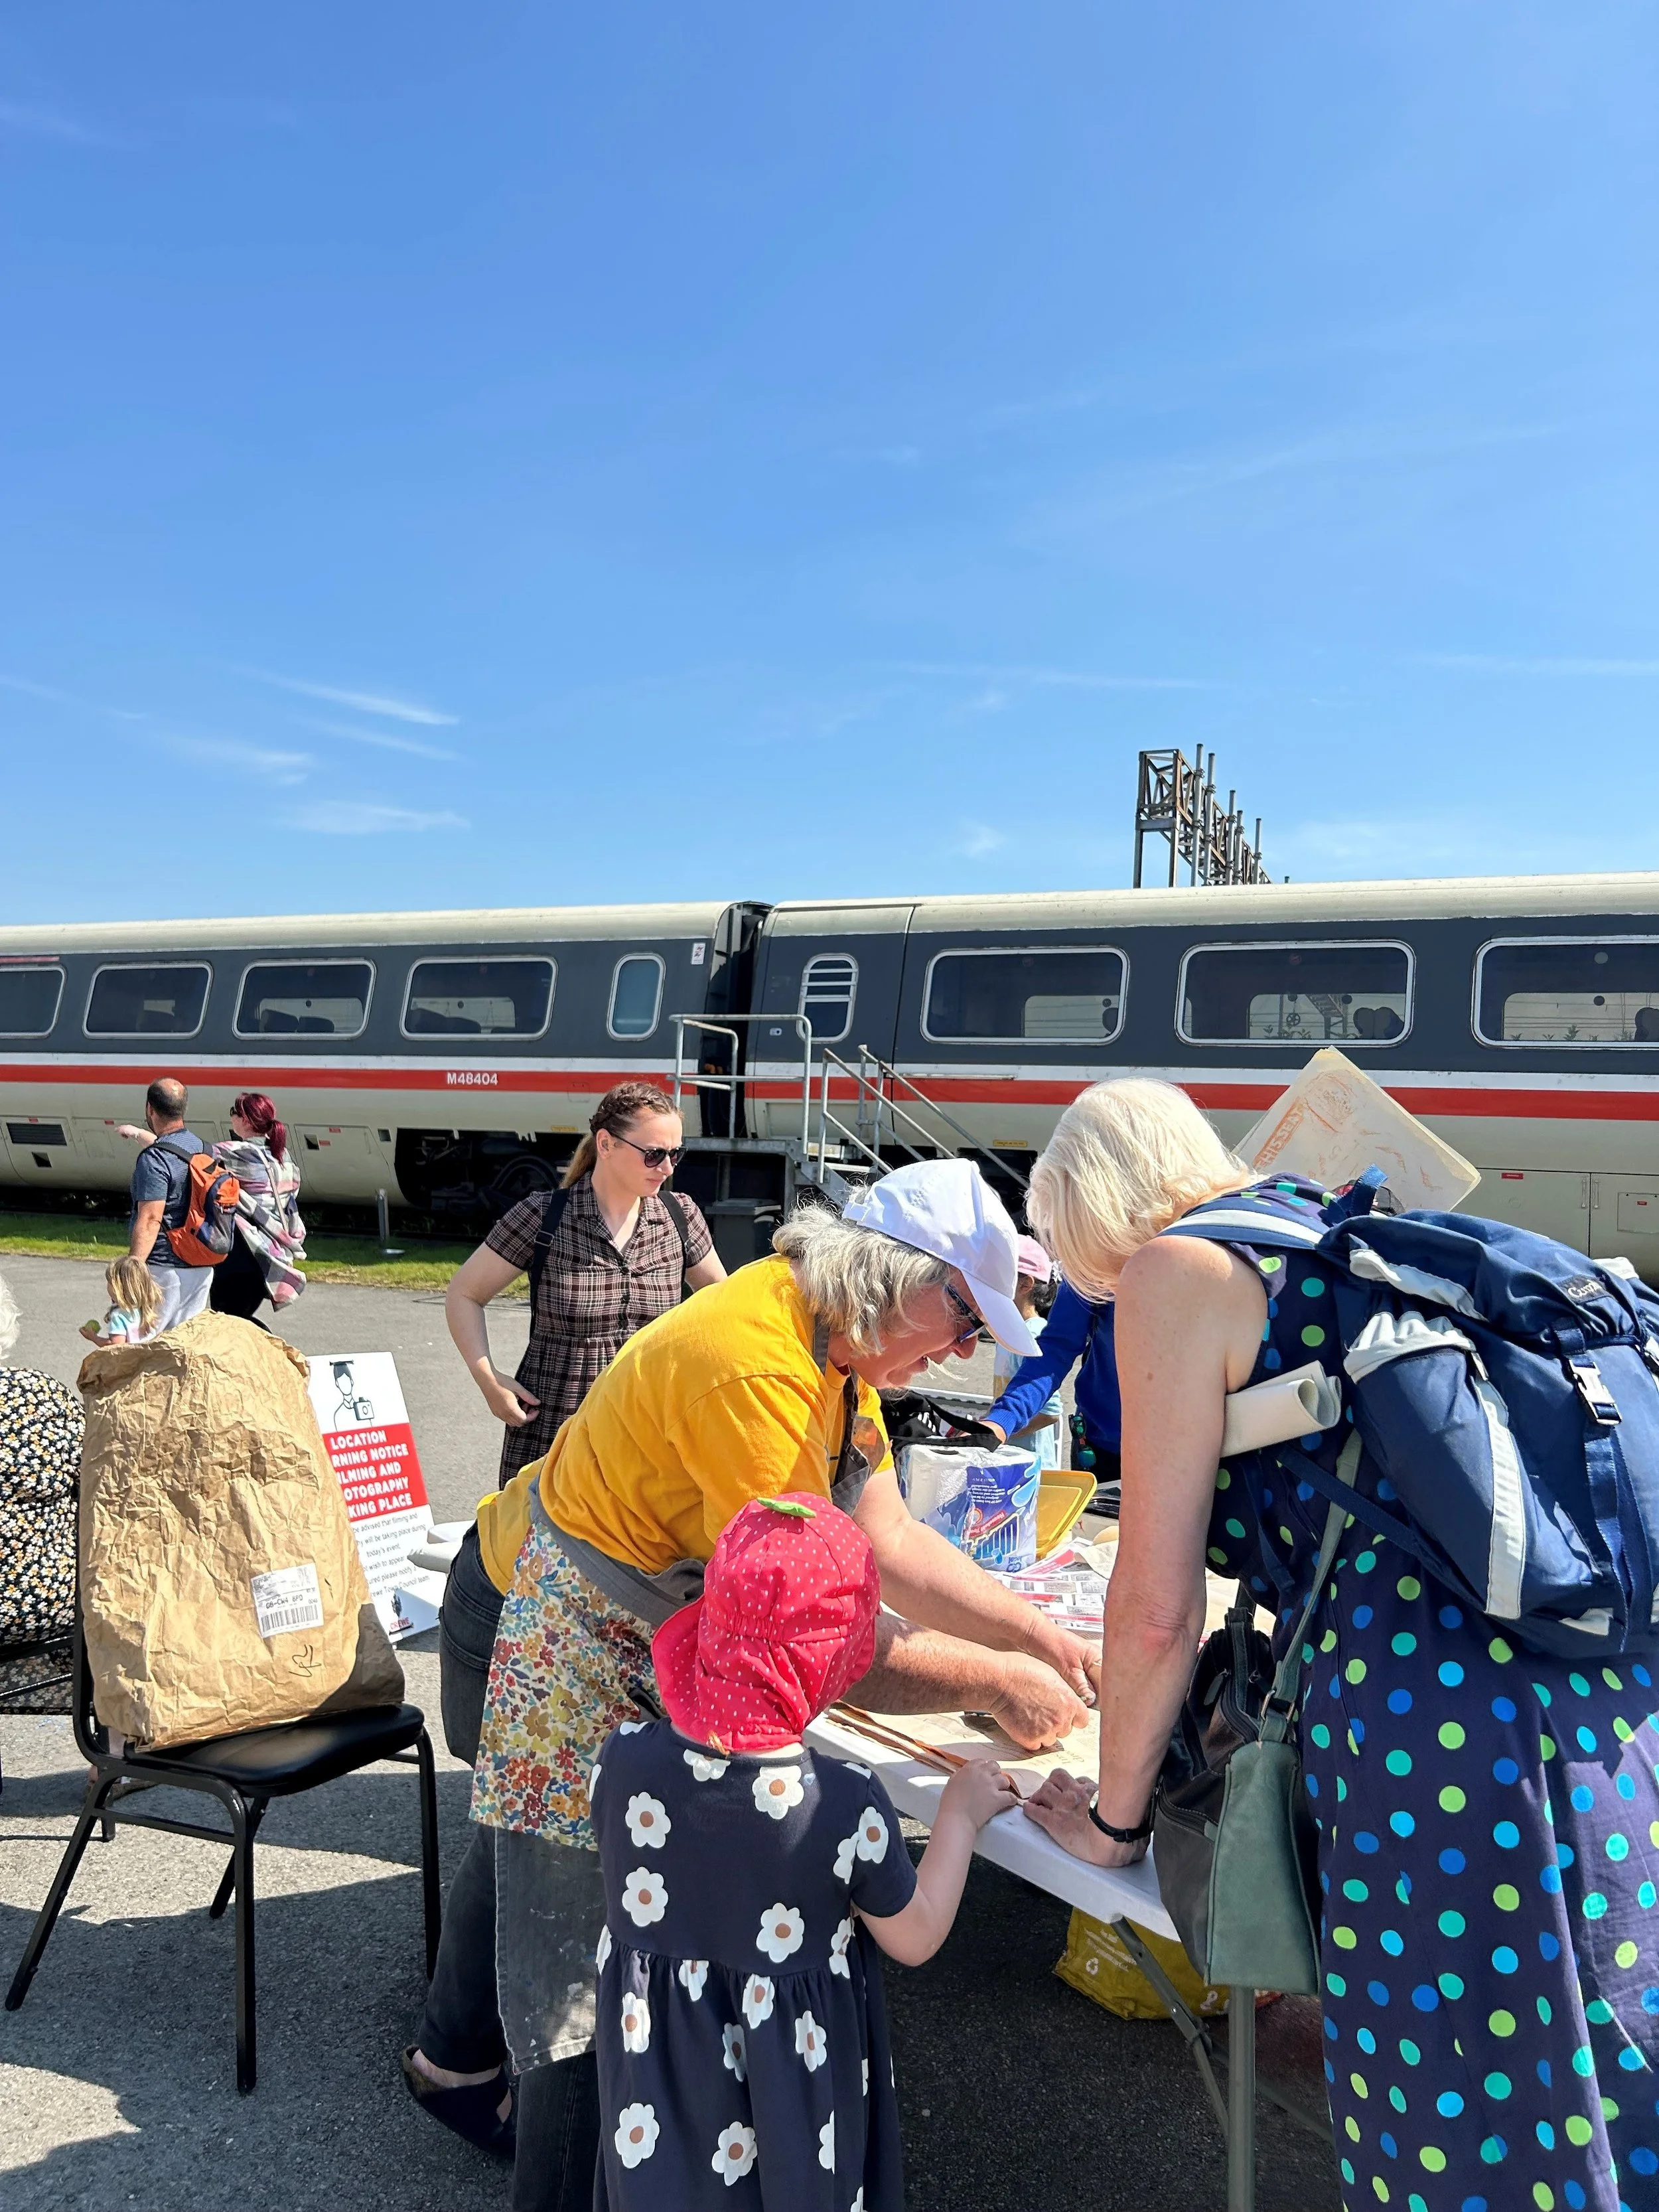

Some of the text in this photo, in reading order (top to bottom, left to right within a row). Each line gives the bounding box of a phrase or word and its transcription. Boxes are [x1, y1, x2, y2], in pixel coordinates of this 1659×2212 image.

[447, 1072, 498, 1085] M48404
[330, 1430, 387, 1450] LOCATION
[331, 1443, 409, 1467] RNING NOTICE
[336, 1461, 401, 1485] ILMING AND
[344, 1476, 409, 1501] OTOGRAPHY
[348, 1493, 413, 1518] KING PLACE
[361, 1522, 380, 1532] advised
[382, 1530, 397, 1539] taking
[398, 1527, 411, 1537] place
[381, 1571, 397, 1582] please
